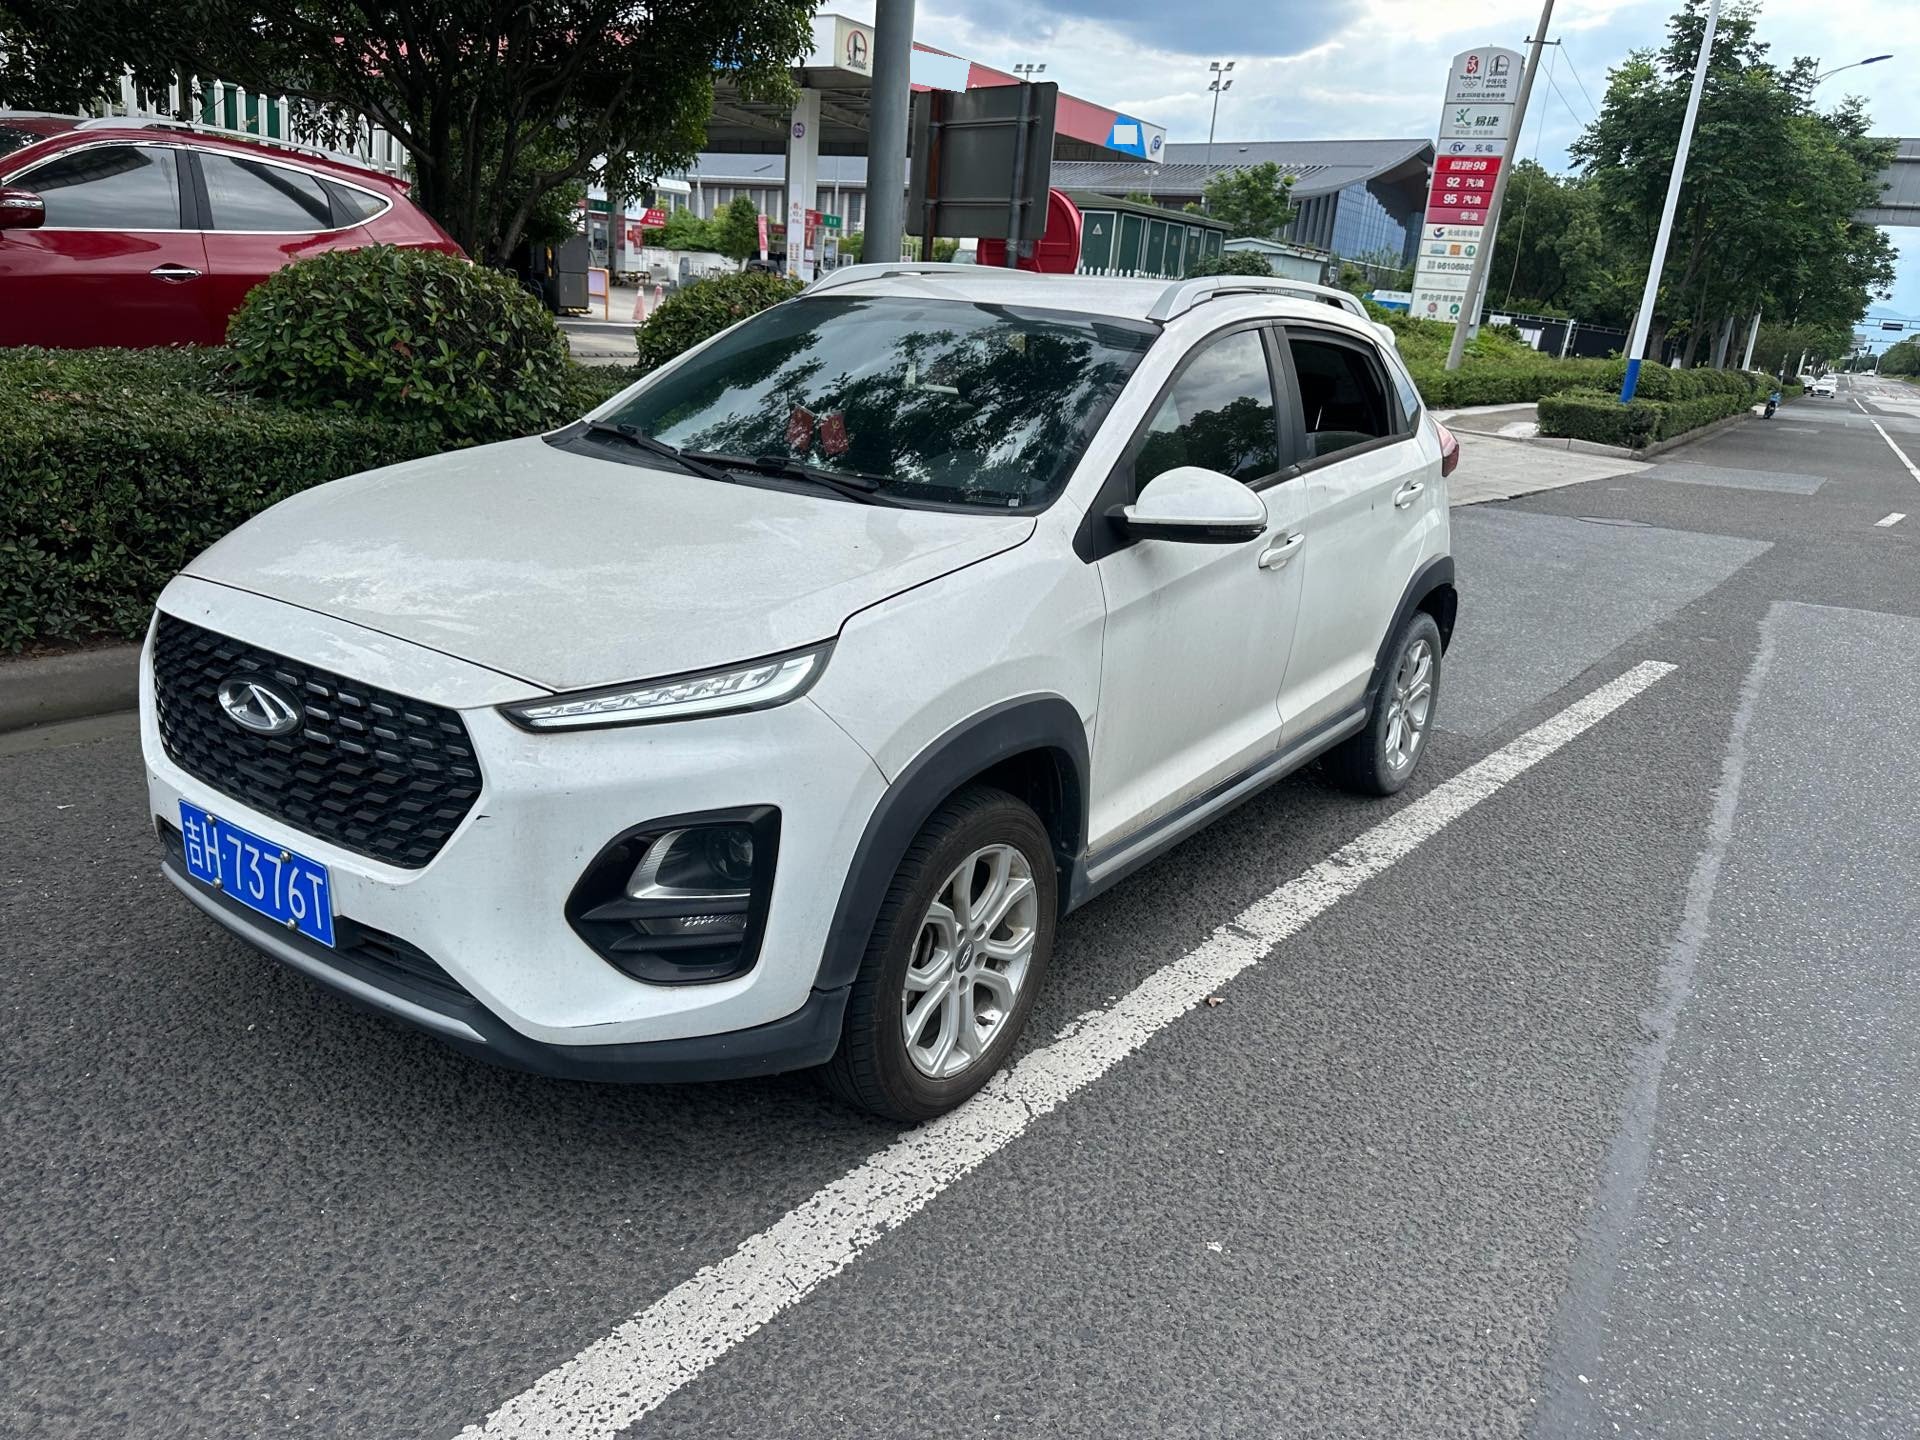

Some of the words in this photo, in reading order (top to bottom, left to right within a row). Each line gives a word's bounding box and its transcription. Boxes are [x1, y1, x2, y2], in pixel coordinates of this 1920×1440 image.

[1475, 115, 1499, 127] 易捷
[1474, 143, 1493, 153] 充电
[1446, 176, 1461, 188] 92
[1465, 178, 1485, 188] 汽油
[1443, 193, 1458, 205] 95
[1462, 195, 1482, 205] 汽油
